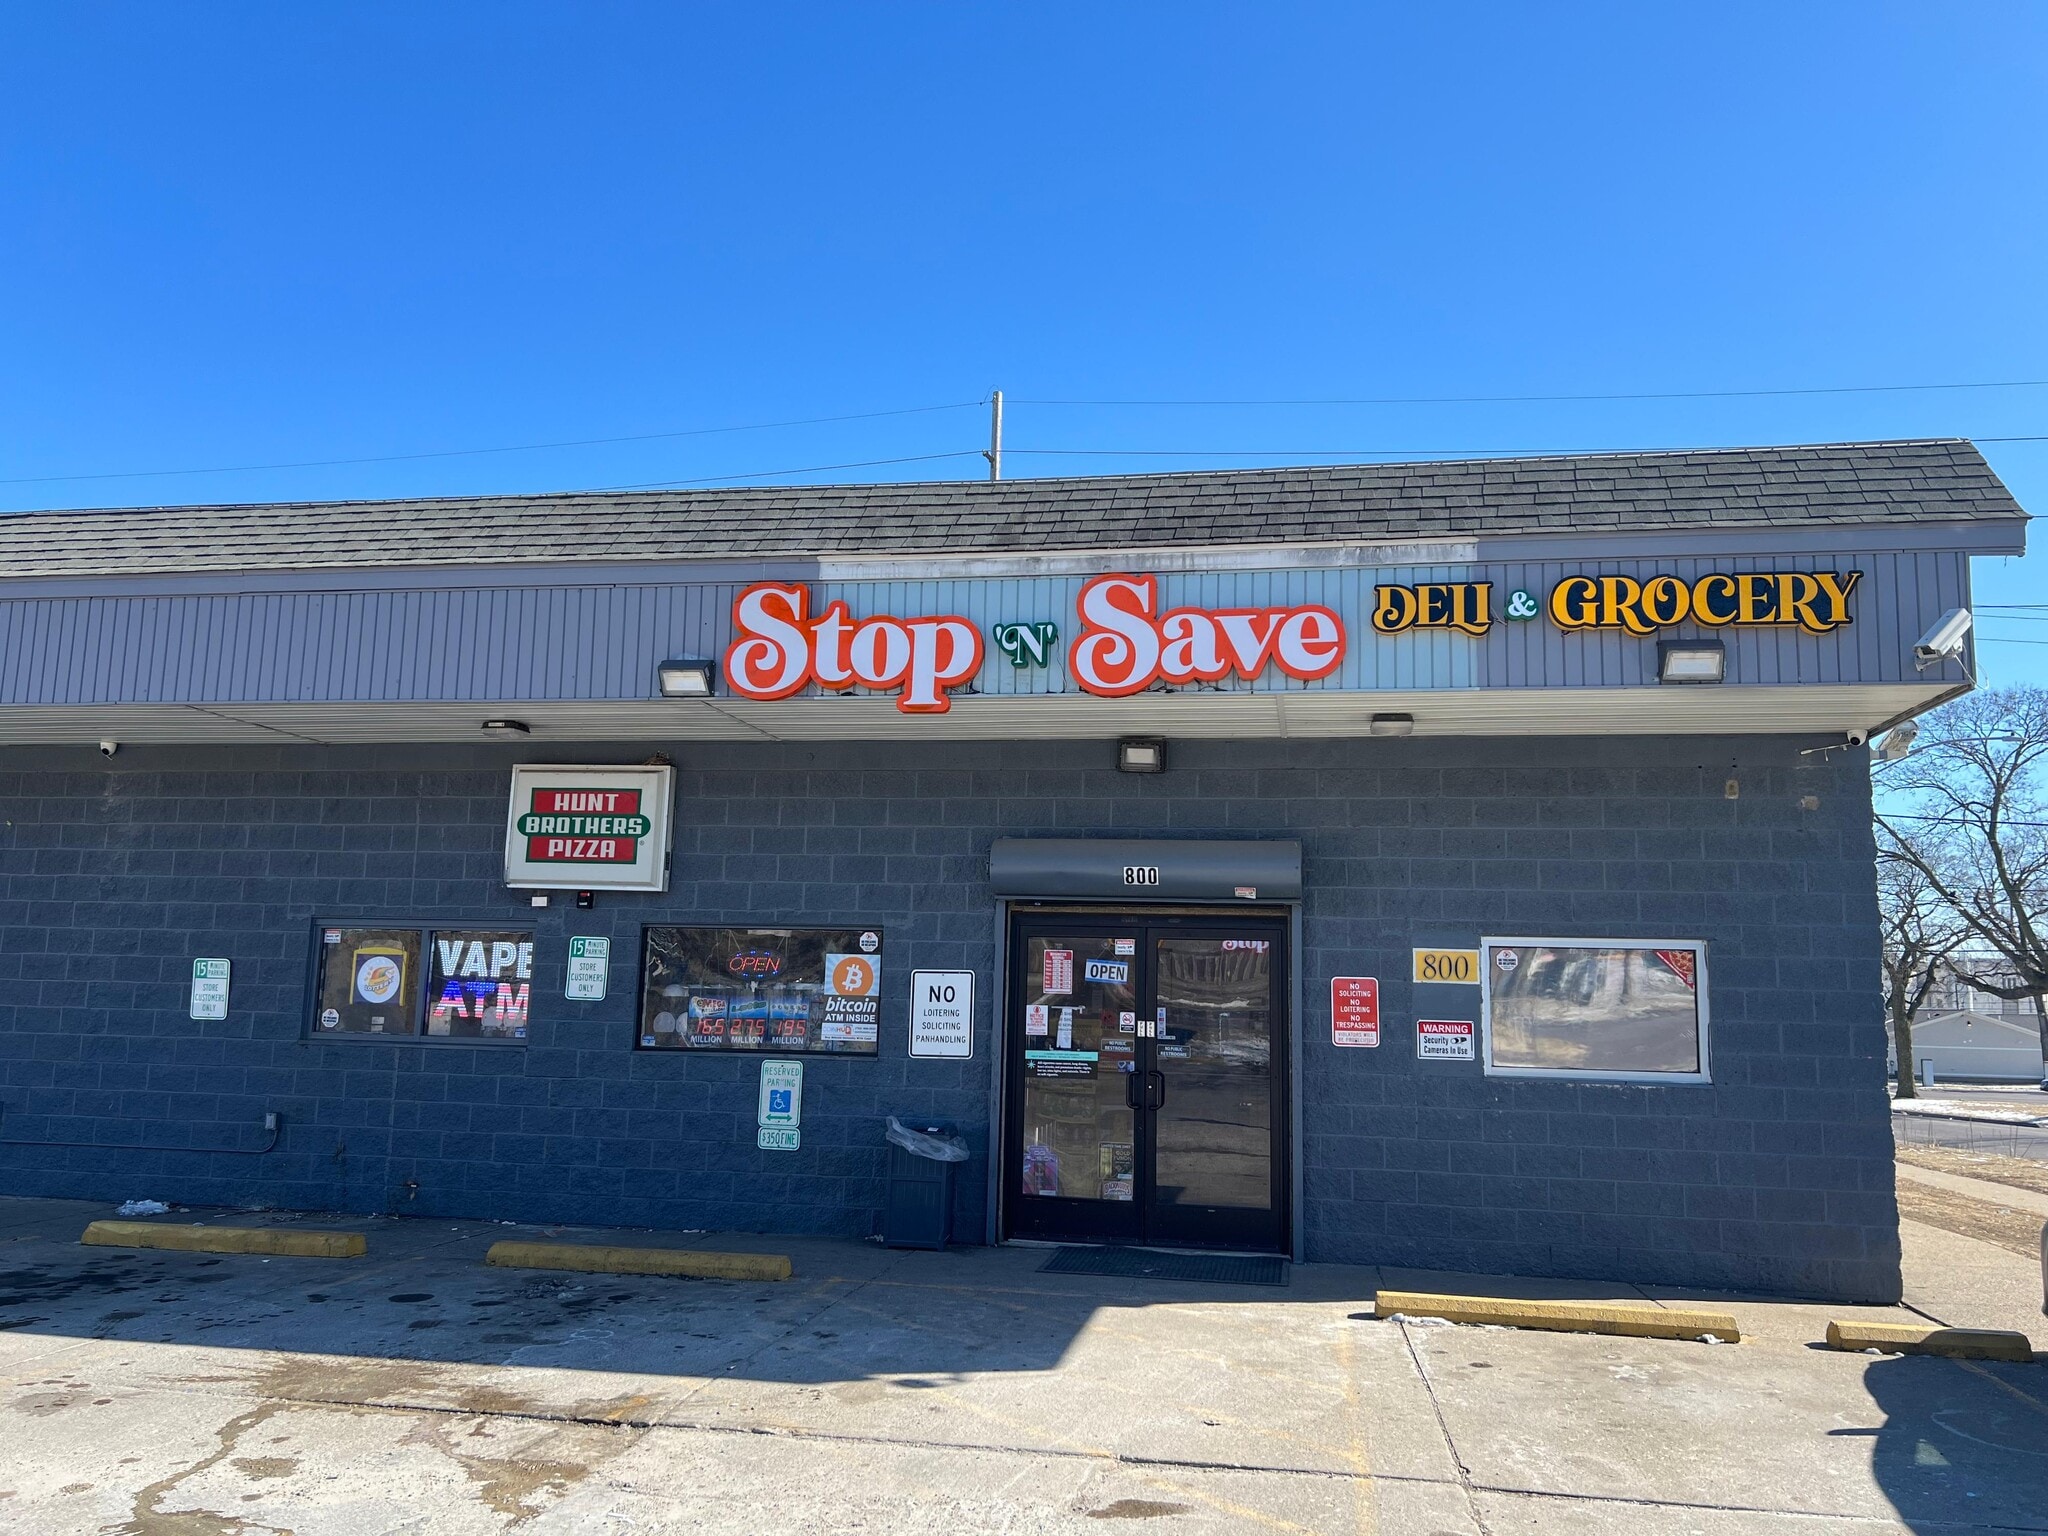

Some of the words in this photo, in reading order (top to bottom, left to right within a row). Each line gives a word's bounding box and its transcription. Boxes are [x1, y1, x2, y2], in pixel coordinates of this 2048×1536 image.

[1372, 580, 1494, 637] DELI
[1506, 589, 1540, 621] &
[1549, 570, 1864, 637] GROCERY
[725, 583, 980, 711] Stop
[993, 623, 1057, 667] 'N'
[1072, 575, 1344, 693] Save
[554, 793, 619, 812] HUNT
[525, 816, 643, 835] BROTHERS
[548, 839, 616, 858] PIZZA
[1125, 867, 1157, 884] 800
[572, 940, 584, 955] 15
[586, 948, 606, 956] PARKING
[437, 939, 534, 979] VAPE
[729, 956, 780, 972] OPEN
[196, 962, 207, 976] 15
[579, 963, 597, 971] STORE
[1090, 964, 1125, 980] OPEN
[1423, 954, 1469, 980] 800
[570, 973, 604, 982] CUSTOMERS
[202, 984, 219, 992] STORE
[578, 984, 594, 992] ONLY
[195, 993, 225, 1002] CUSTOMERS
[929, 985, 955, 1003] NO
[1338, 990, 1372, 998] SOLICITING
[433, 980, 530, 1020] ATM
[825, 996, 877, 1013] bitcoin
[1350, 998, 1360, 1006] NO
[201, 1004, 217, 1012] ONLY
[923, 1008, 960, 1017] LOITERING
[825, 1013, 844, 1021] ATM
[846, 1014, 876, 1023] INSIDE
[922, 1022, 961, 1030] SOLICITING
[1336, 1021, 1376, 1029] TRESPASSING
[1423, 1024, 1469, 1034] WARNING
[690, 1035, 722, 1043] MILLION
[731, 1036, 763, 1044] MILLION
[771, 1036, 804, 1044] MILLION
[915, 1034, 967, 1044] PANHANDLING
[1423, 1035, 1449, 1046] Security
[1423, 1046, 1449, 1055] Cameras
[1450, 1046, 1456, 1054] In
[1457, 1046, 1468, 1055] Use
[764, 1066, 800, 1077] RESERVED
[781, 1132, 796, 1146] FINE
